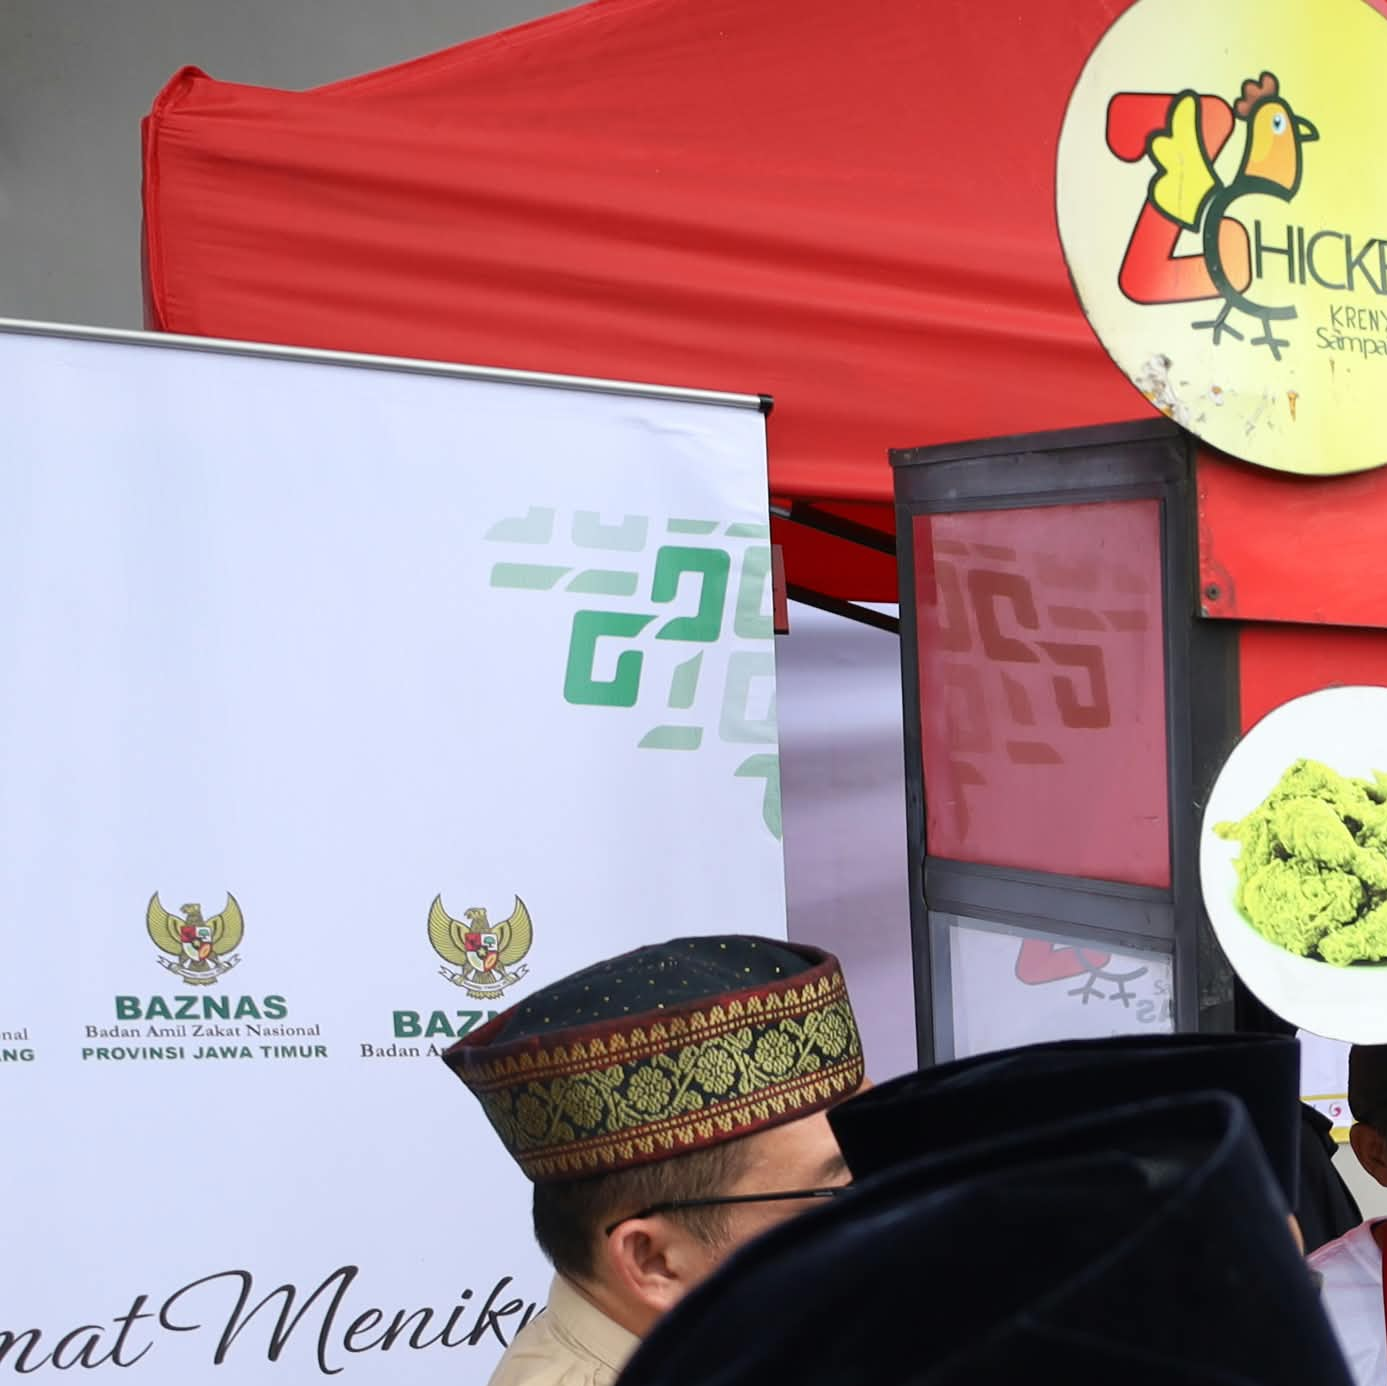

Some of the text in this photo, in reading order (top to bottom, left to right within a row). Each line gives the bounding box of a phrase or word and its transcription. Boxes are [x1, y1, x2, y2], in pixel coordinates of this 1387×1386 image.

[115, 994, 288, 1020] BAZNAS
[85, 1024, 320, 1038] Badan Amil Zakat Nasional
[393, 1010, 501, 1038] BAZ
[82, 1045, 328, 1060] PROVINSI JAWA TIMUR
[360, 1043, 420, 1057] Badan
